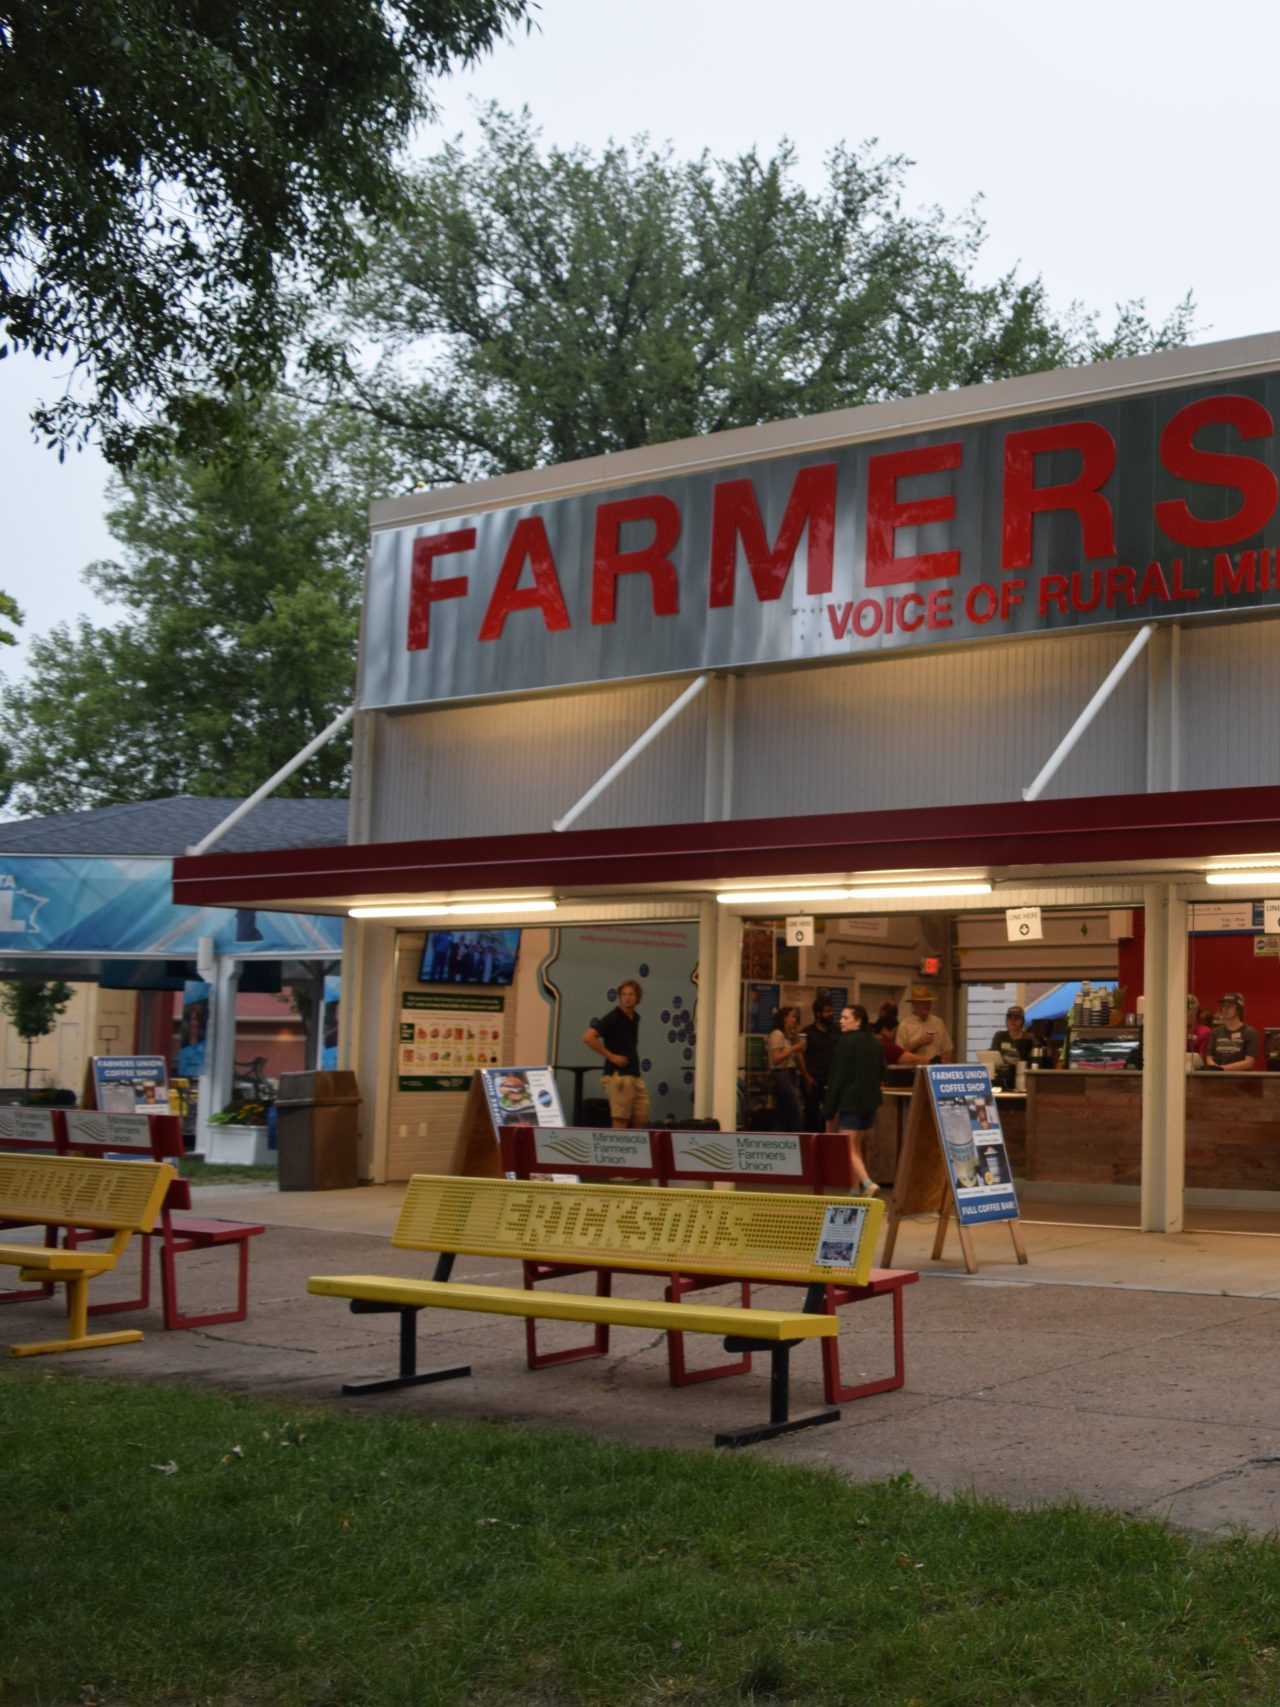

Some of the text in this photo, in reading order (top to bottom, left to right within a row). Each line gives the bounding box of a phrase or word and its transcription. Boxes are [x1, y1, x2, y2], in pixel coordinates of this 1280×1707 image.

[407, 394, 1279, 651] FARMERS
[827, 588, 952, 641] VOICE
[965, 578, 1026, 626] OF
[1038, 560, 1199, 617] RURAL
[104, 1069, 158, 1077] COFFEE SHOP
[931, 1070, 988, 1080] FARMERS UNION
[940, 1082, 986, 1093] COFFEE SHOP
[592, 1132, 648, 1145] Minnesota
[736, 1137, 797, 1150] Minnesota
[593, 1143, 638, 1155] Farmers
[594, 1154, 626, 1165] Union
[737, 1150, 786, 1161] Farmers
[738, 1161, 773, 1171] Union
[961, 1206, 978, 1215] FULL
[978, 1202, 1001, 1213] COFFEE
